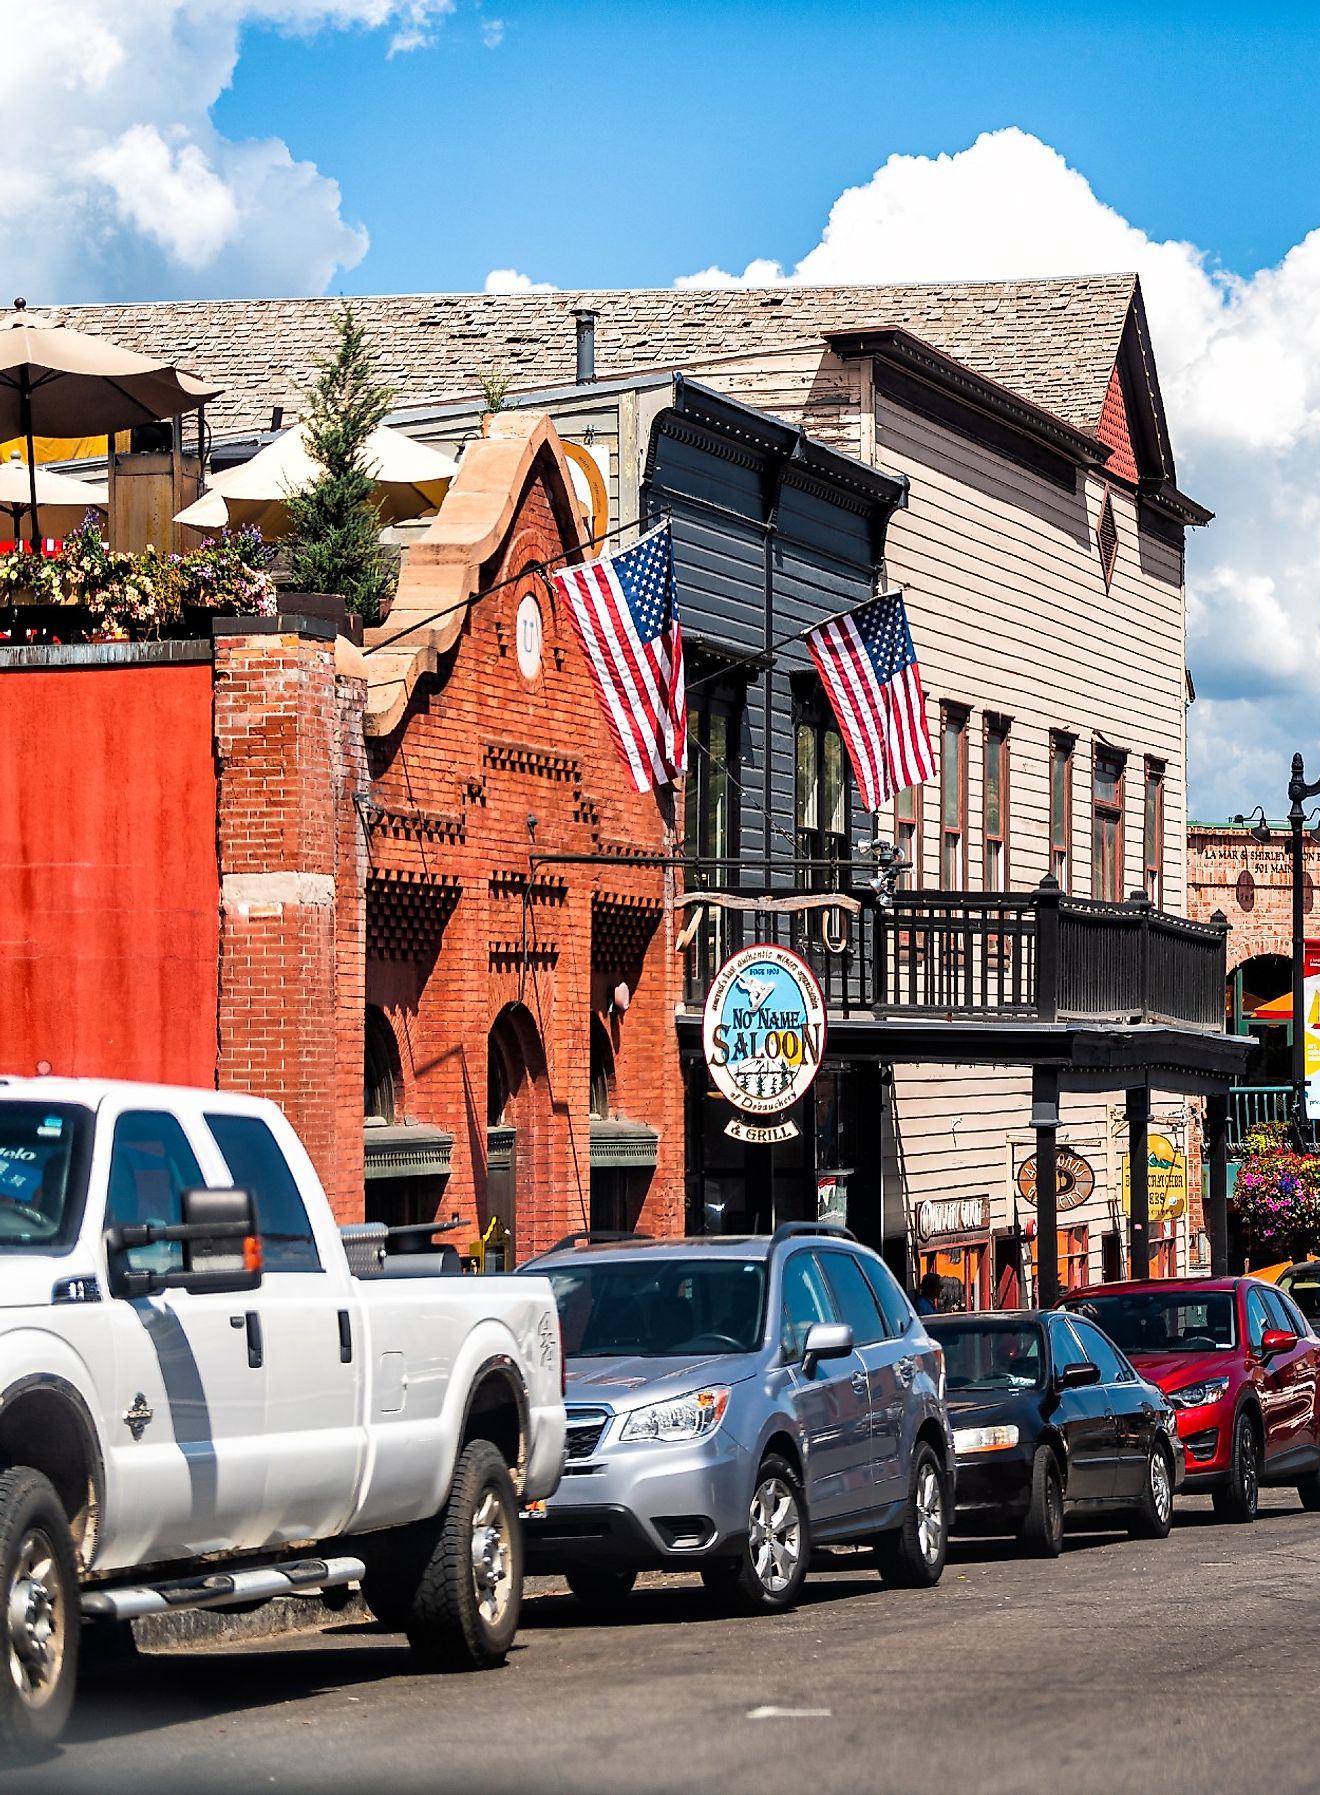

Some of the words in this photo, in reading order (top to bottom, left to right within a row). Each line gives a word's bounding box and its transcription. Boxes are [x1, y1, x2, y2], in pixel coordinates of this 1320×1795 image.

[1205, 850, 1217, 860] LA
[1219, 850, 1237, 860] MAR
[1240, 850, 1248, 860] &
[1250, 850, 1285, 861] SHIRLEY
[1255, 863, 1269, 874] 501
[732, 1007, 753, 1030] NO
[757, 1007, 801, 1030] NAME
[709, 1022, 822, 1067] SALOON
[731, 1124, 741, 1137] &
[746, 1126, 793, 1142] GRILL
